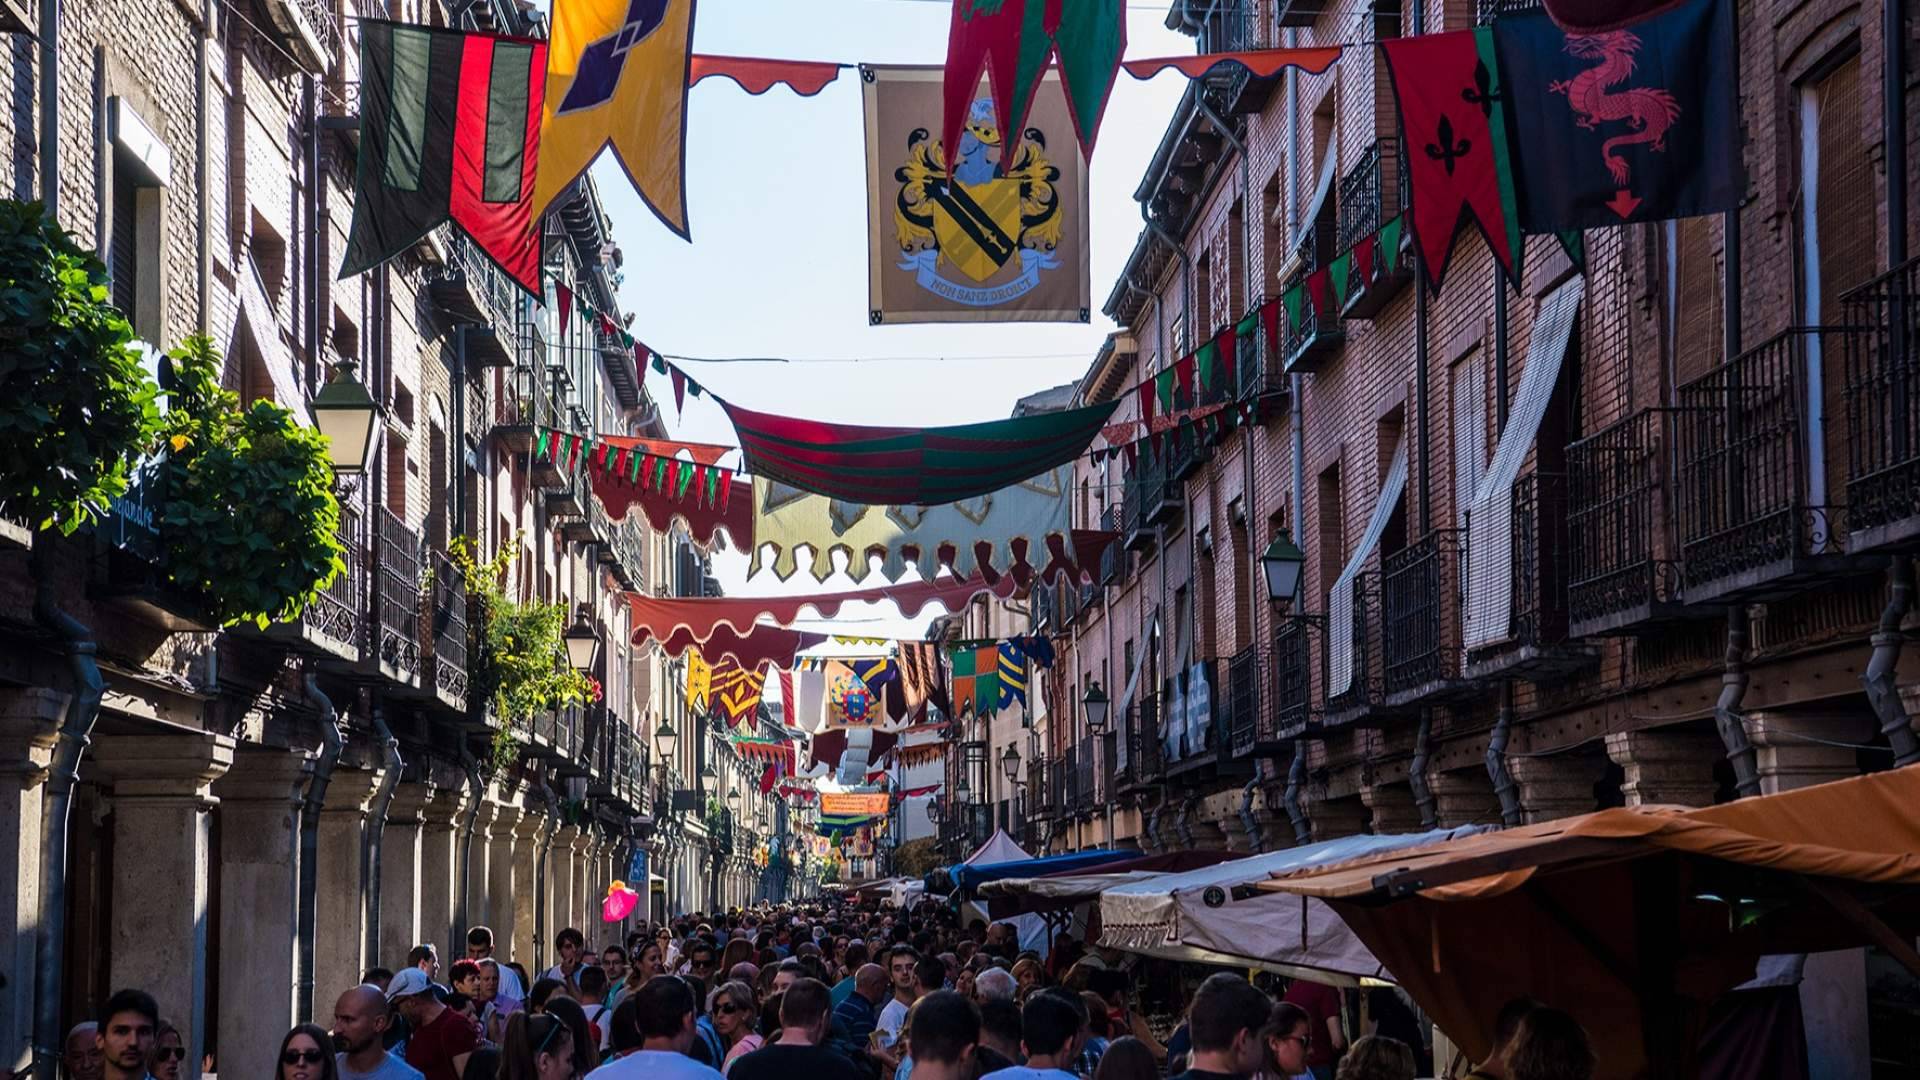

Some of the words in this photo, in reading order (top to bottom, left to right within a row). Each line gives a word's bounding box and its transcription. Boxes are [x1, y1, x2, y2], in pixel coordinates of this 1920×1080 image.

[931, 279, 957, 297] NON
[957, 289, 988, 302] SANZ
[991, 277, 1032, 300] DROICT
